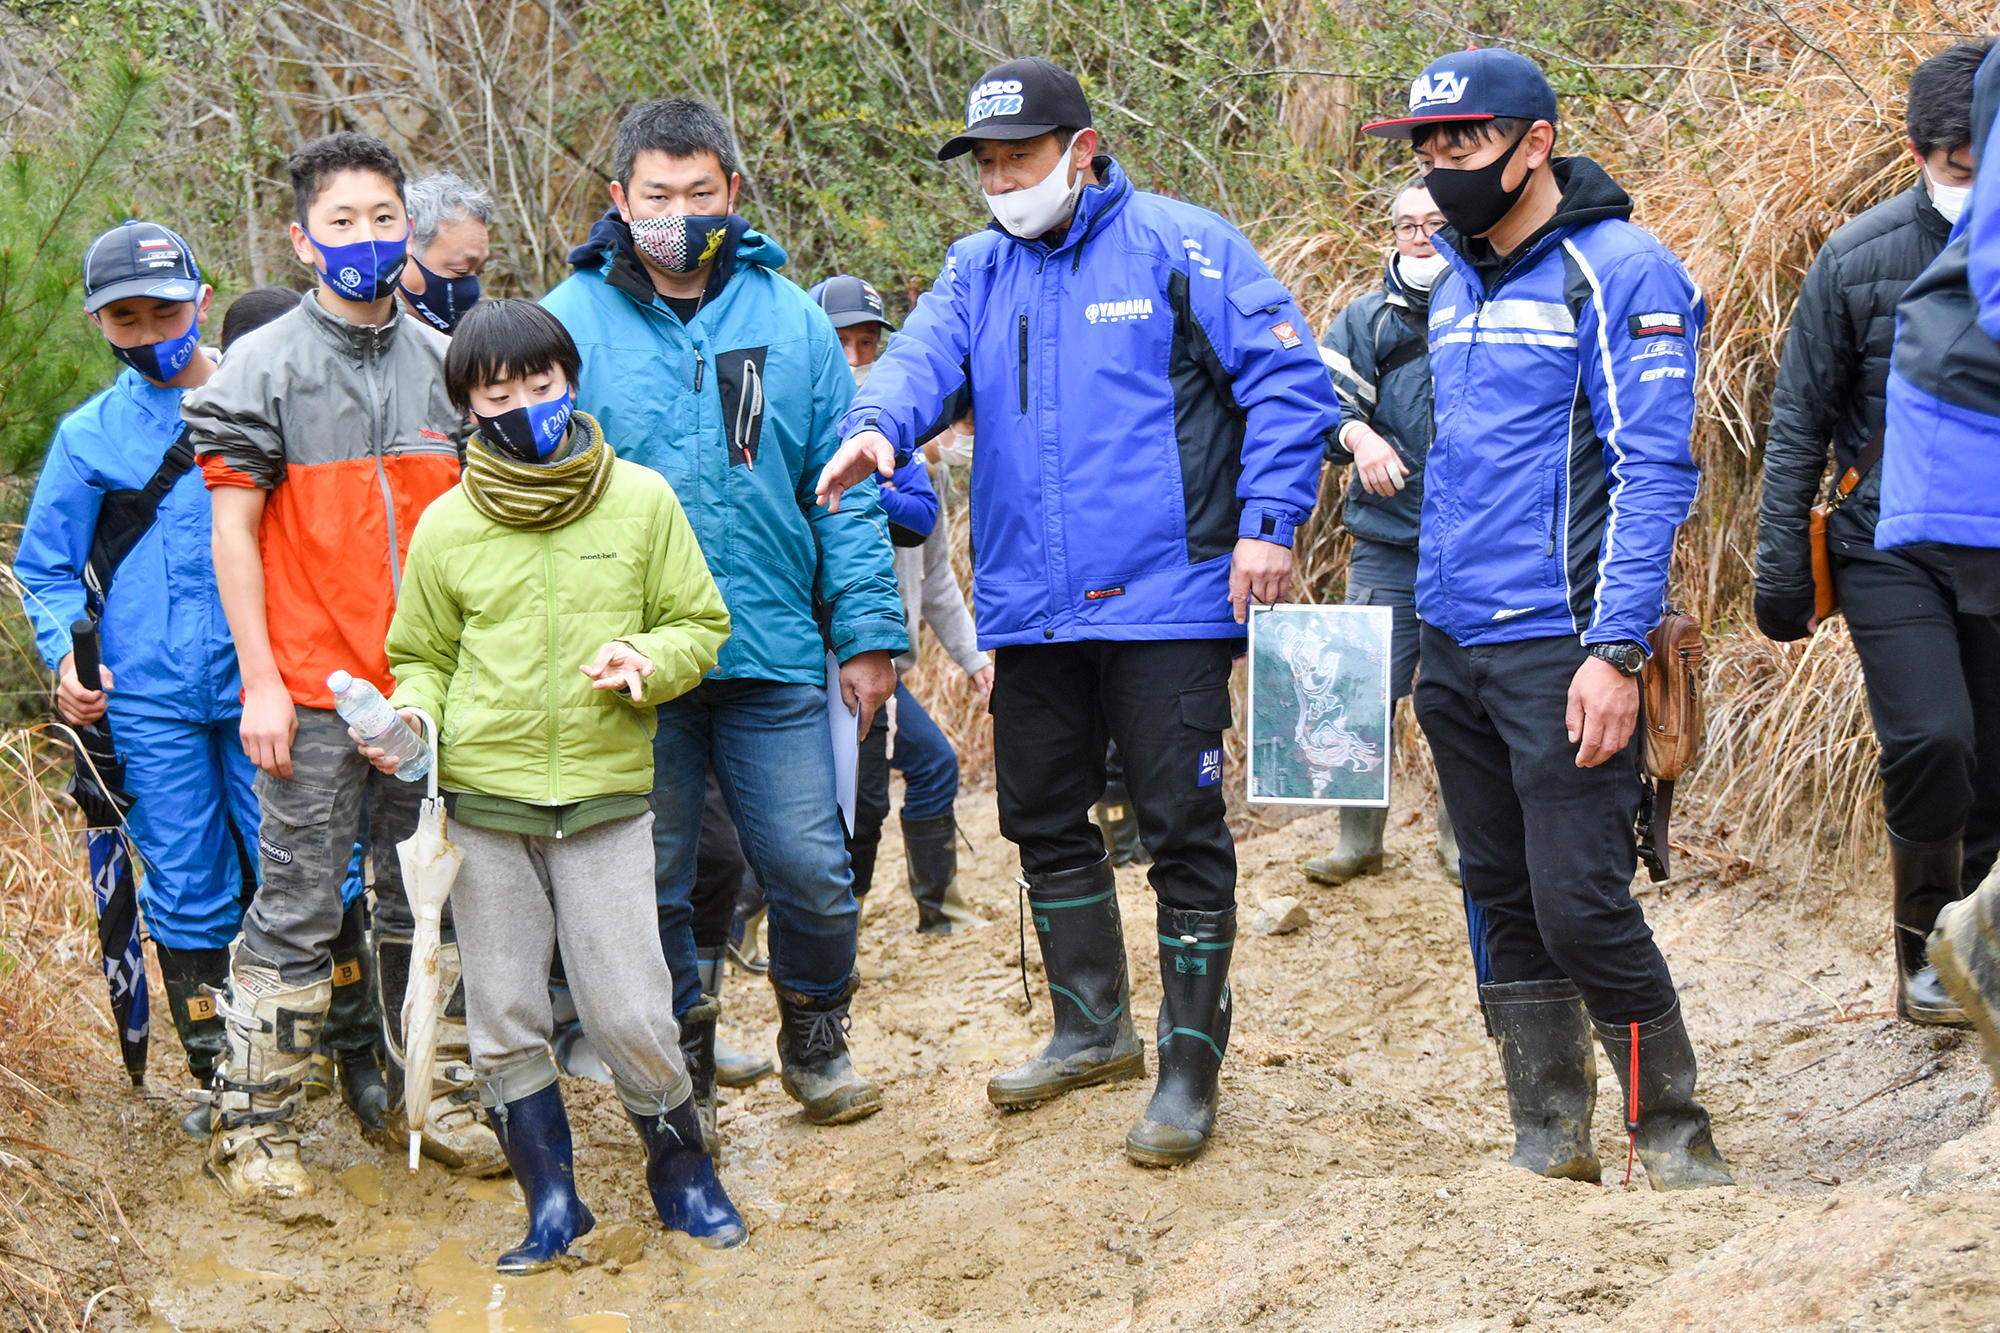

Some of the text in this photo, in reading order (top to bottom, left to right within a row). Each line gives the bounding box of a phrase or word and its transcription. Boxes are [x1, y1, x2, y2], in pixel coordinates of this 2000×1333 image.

[332, 278, 363, 299] YAMAHA
[1098, 298, 1153, 317] YAMAHA
[548, 409, 565, 432] 20
[342, 966, 352, 978] B
[199, 1000, 209, 1012] B
